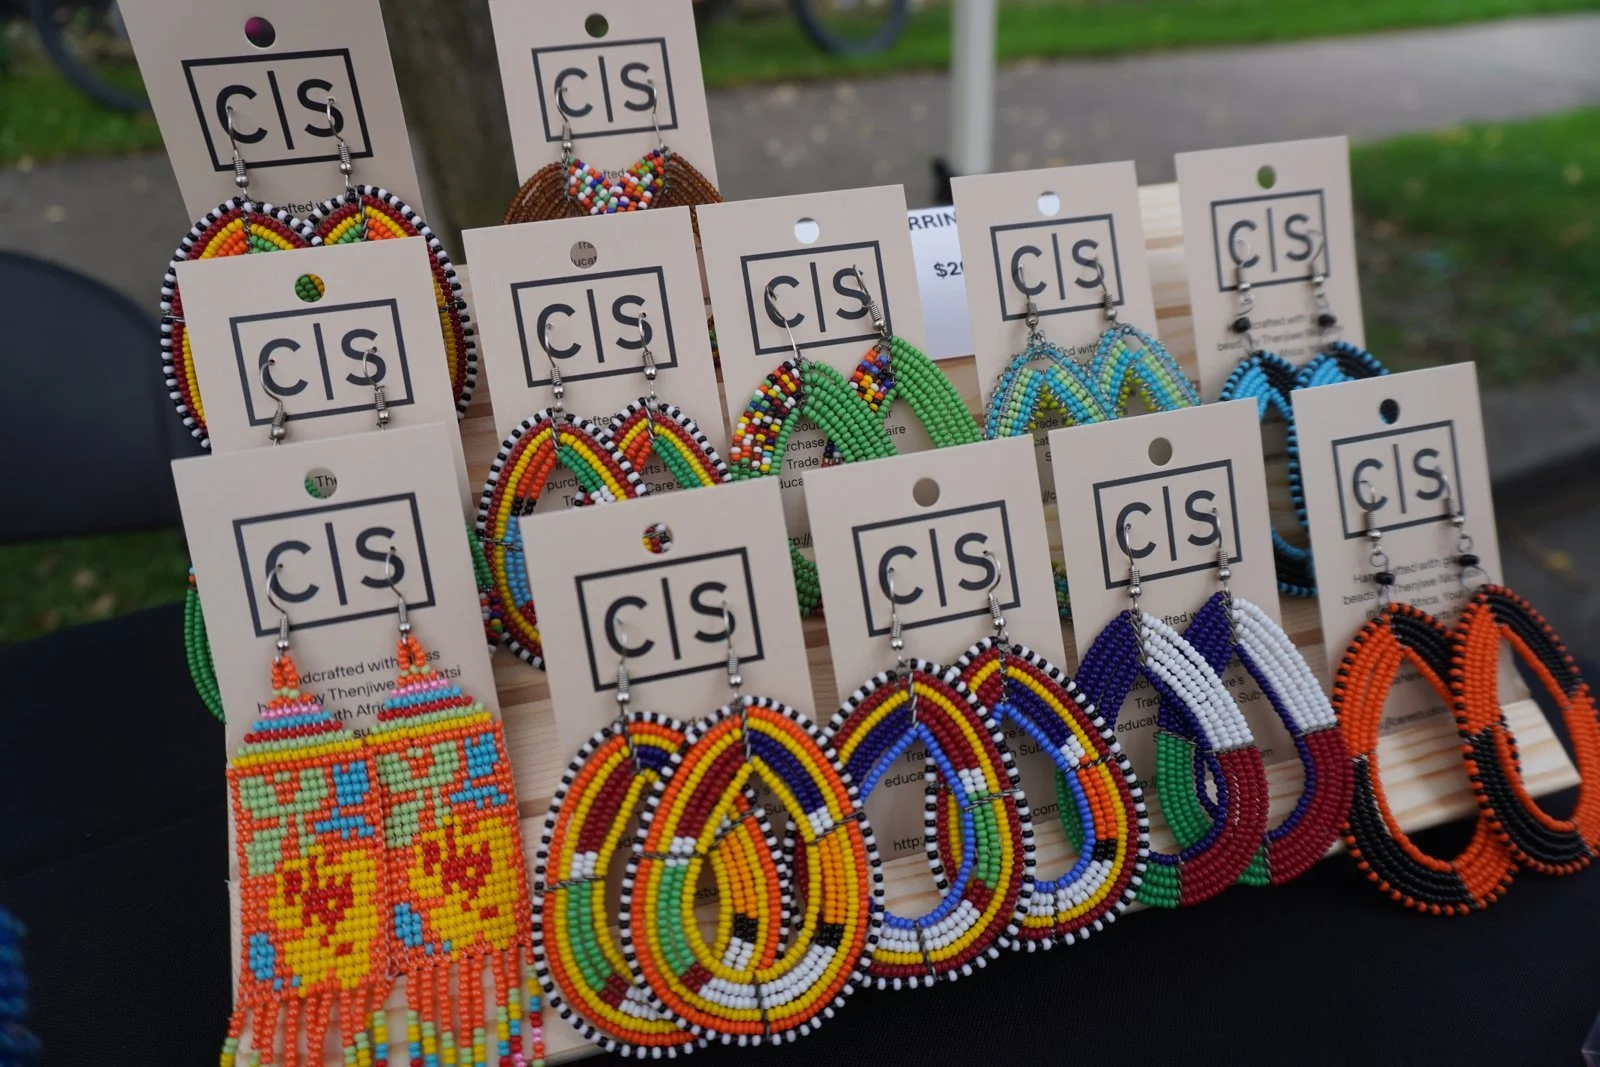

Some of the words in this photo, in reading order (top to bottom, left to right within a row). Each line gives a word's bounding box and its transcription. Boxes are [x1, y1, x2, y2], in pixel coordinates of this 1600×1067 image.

[908, 212, 957, 231] RRIN
[933, 261, 964, 279] $2
[885, 425, 906, 436] aire
[786, 456, 819, 470] Trade
[327, 679, 395, 702] Thenjiwe
